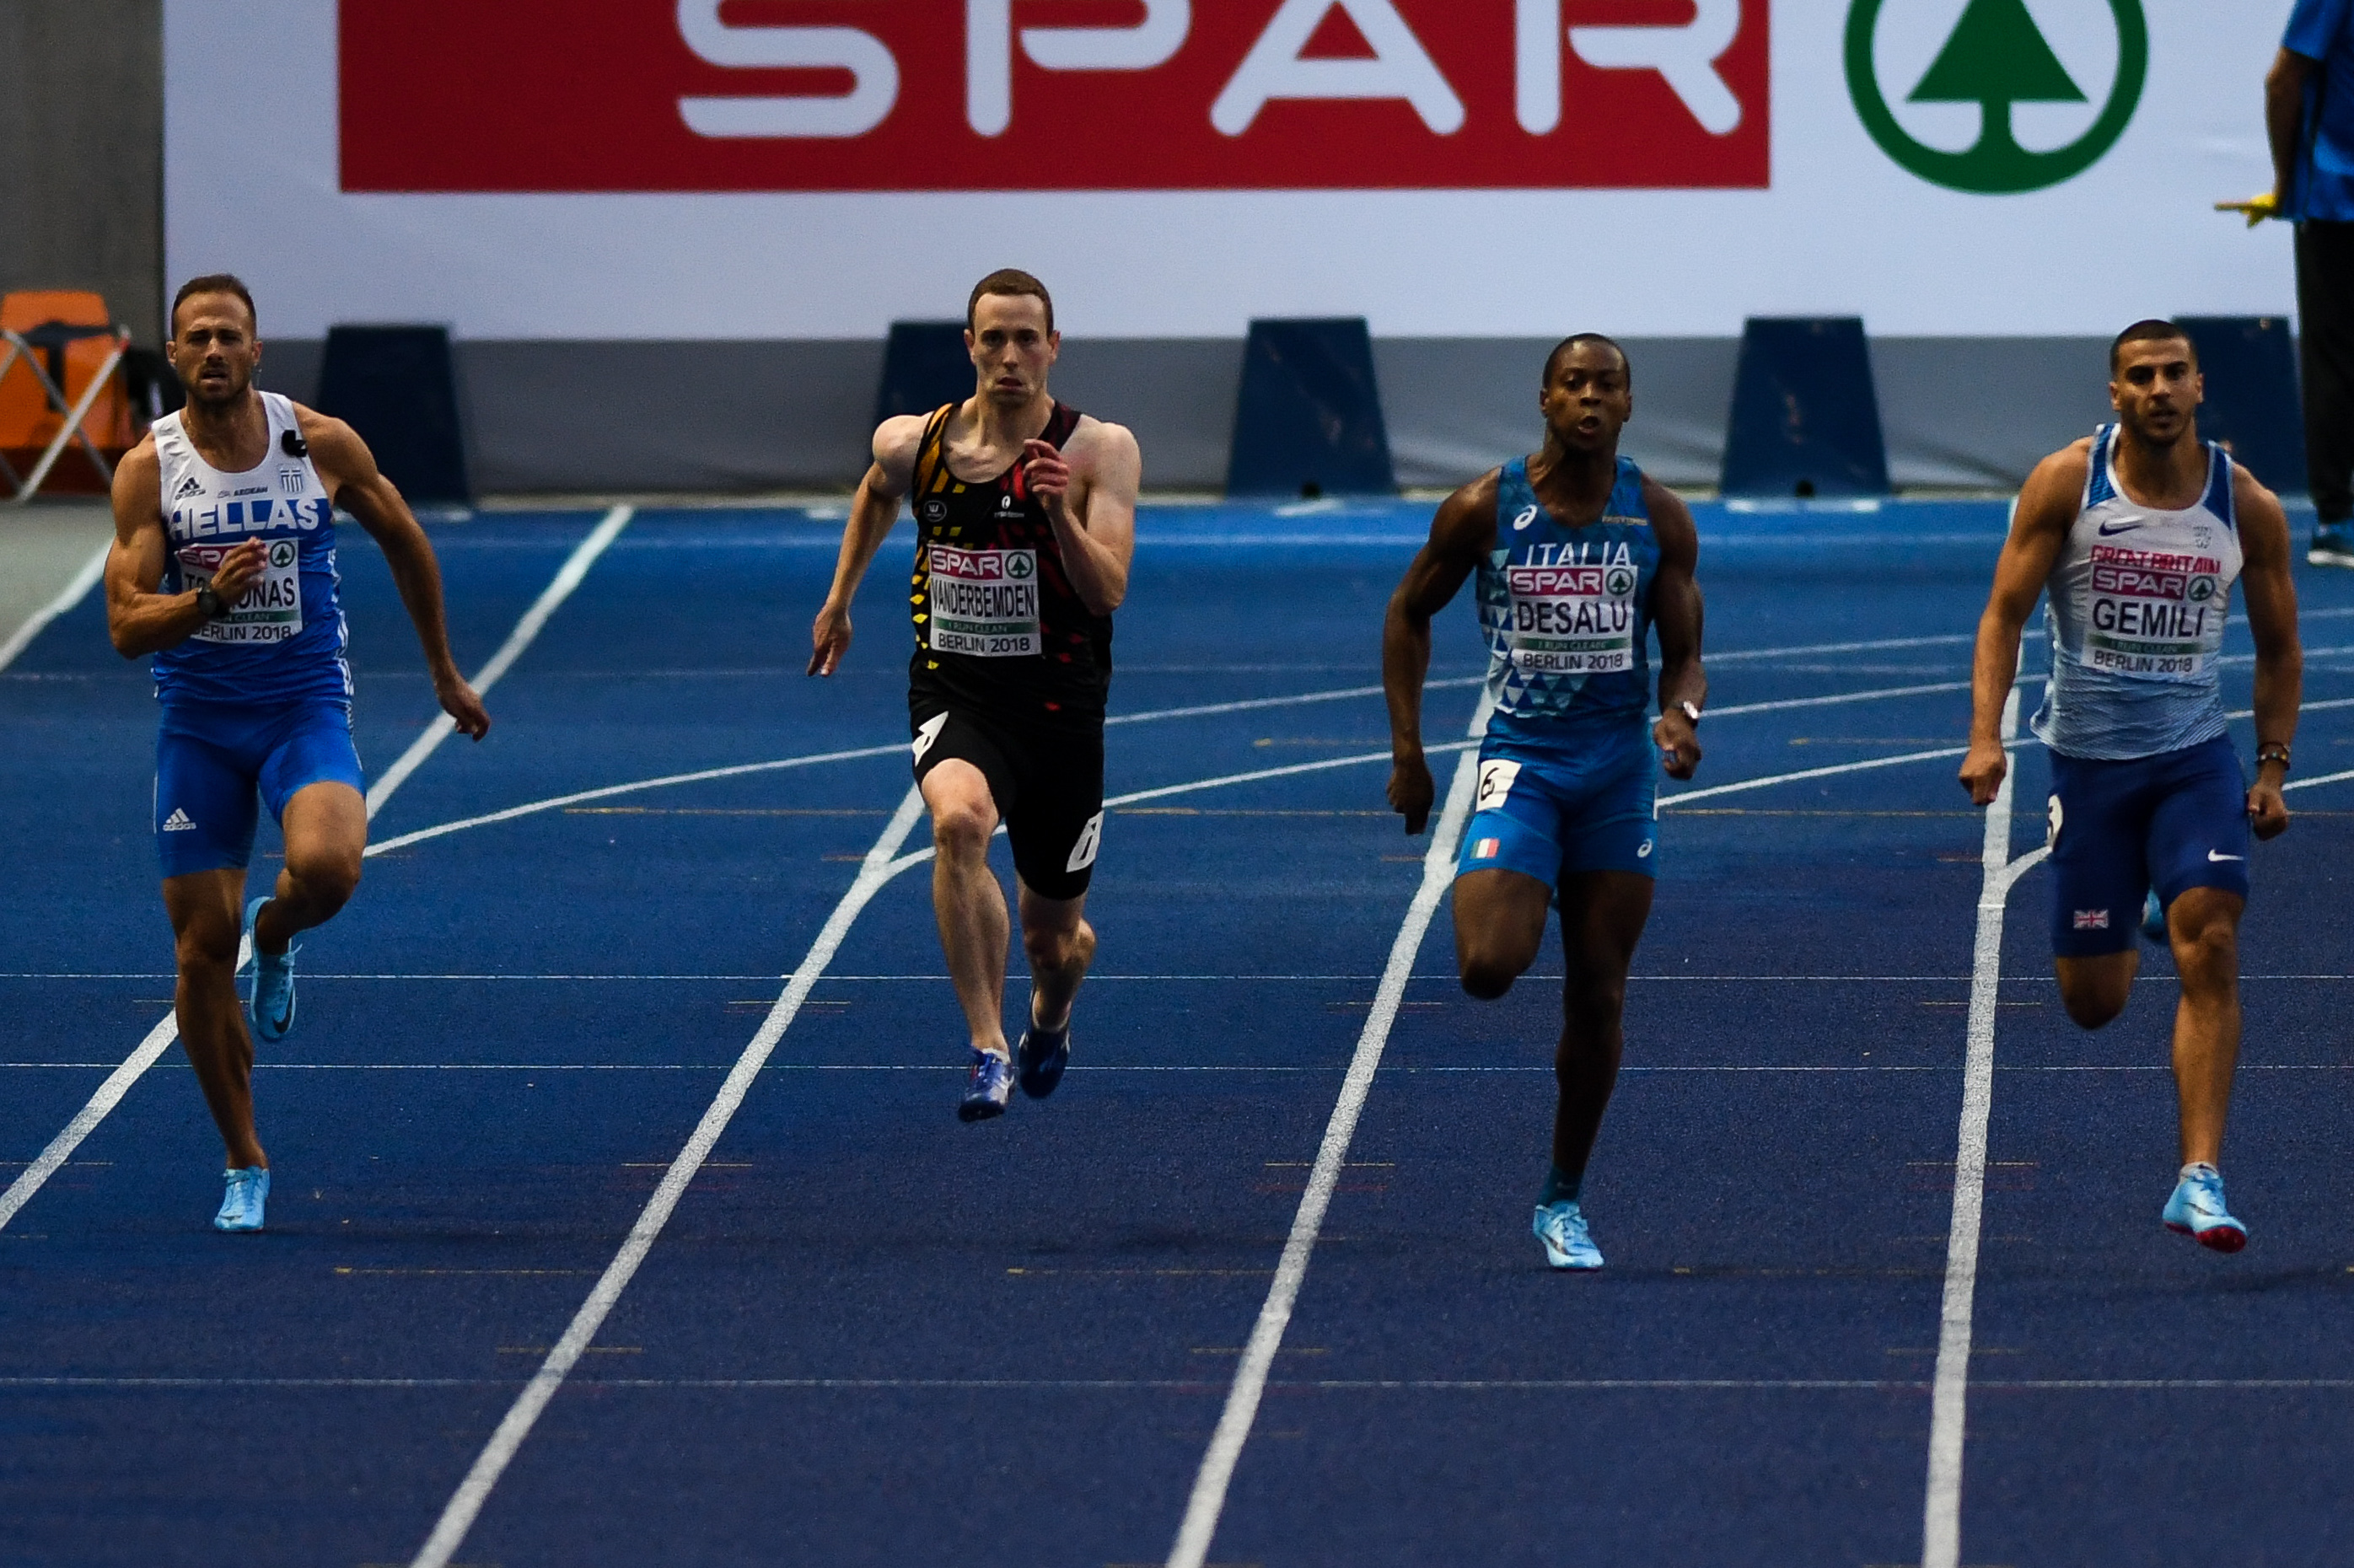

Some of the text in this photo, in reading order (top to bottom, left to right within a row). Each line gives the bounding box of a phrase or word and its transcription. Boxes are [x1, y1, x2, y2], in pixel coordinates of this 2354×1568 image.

[677, 0, 1743, 137] SPAR
[169, 499, 319, 540] HELLAS
[932, 550, 1000, 576] SPAR
[2091, 545, 2221, 574] GREAT BRITAIN
[1513, 572, 1600, 592] SPAR
[2095, 569, 2184, 596] SPAR
[931, 577, 1035, 617] VANDERBEMDEN
[1517, 600, 1627, 634] DESALU
[2093, 599, 2205, 638] GEMILI
[252, 626, 292, 641] 2018
[938, 633, 1030, 652] BERLIN 2018
[1524, 653, 1623, 670] BERLIN 2018
[2093, 650, 2193, 673] BERLIN 2018
[1481, 766, 1500, 802] 6
